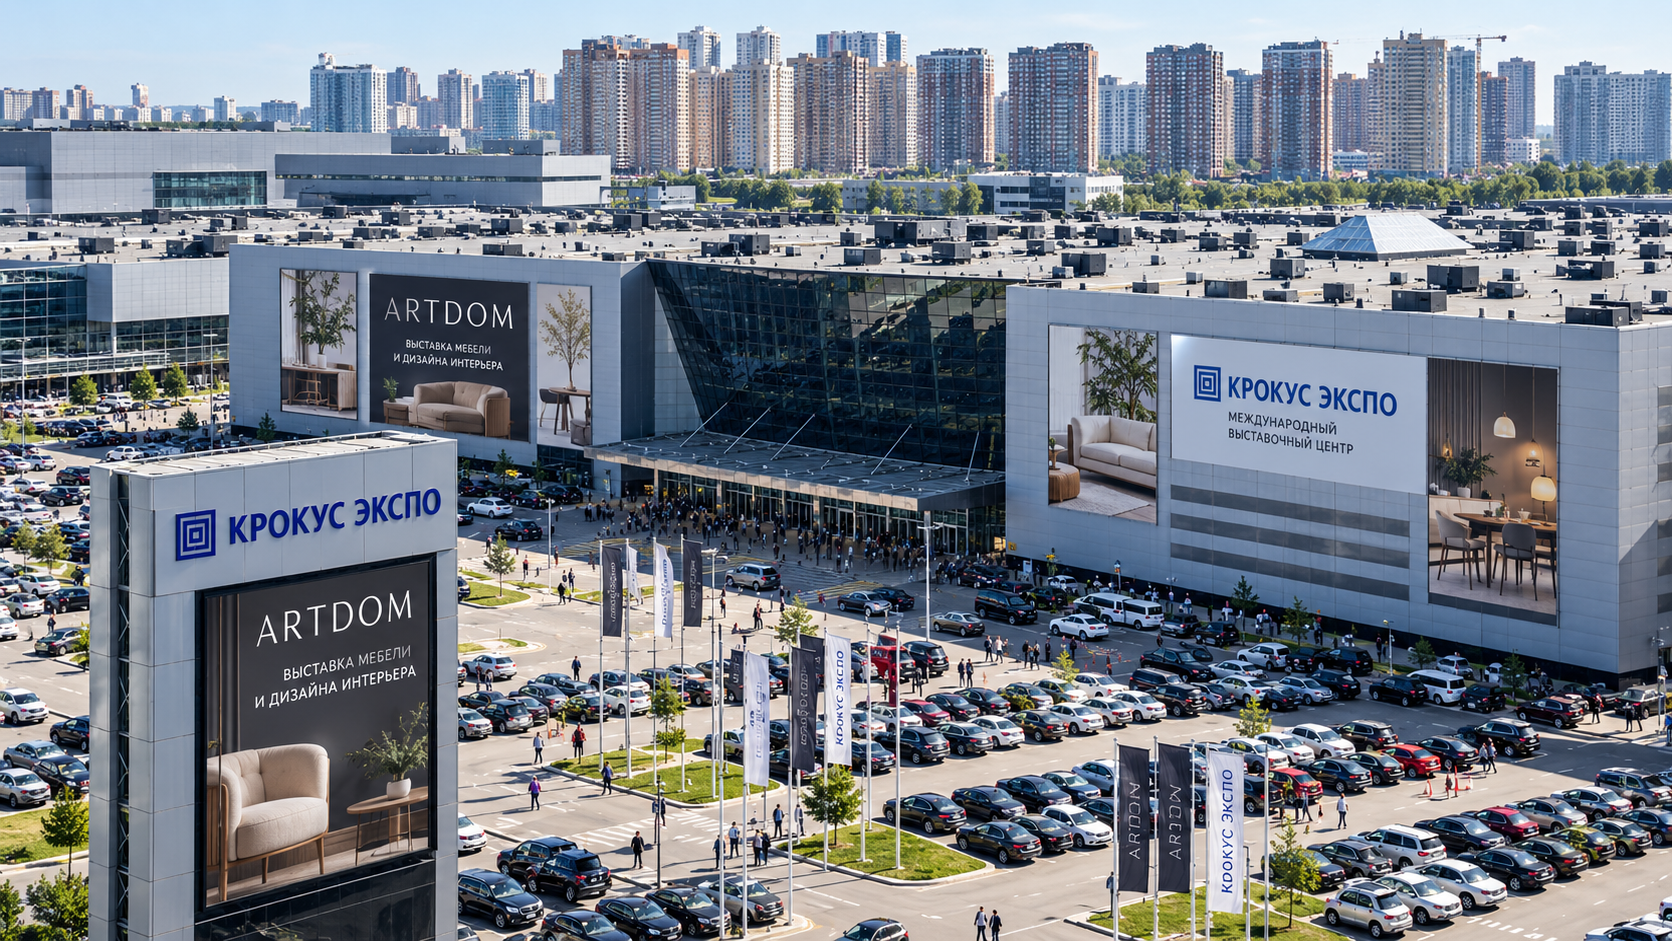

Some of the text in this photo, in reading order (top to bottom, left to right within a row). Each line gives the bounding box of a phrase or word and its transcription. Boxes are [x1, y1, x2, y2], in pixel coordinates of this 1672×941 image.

[384, 297, 513, 329] ARTDOM
[393, 353, 504, 371] И ДИЗАЙНА ИНТЕРЬЕРА
[405, 339, 491, 355] ВЫСТАВКА МЕБЕЛИ
[1228, 375, 1398, 417] КРОКУС ЭКСПО
[1228, 411, 1337, 435] МЕЖДУНАРОДНЫЙ
[1228, 428, 1354, 455] ВЫСТАВОЧНЫЙ ЦЕНТР
[229, 488, 442, 545] КРОКУС ЭКСПО
[256, 590, 412, 648] ARTDOM
[283, 645, 411, 681] ВЫСТАВКА МЕБЕЛИ
[835, 650, 844, 692] ЭКСПО
[255, 665, 417, 709] И ДИЗАЙНА ИНТЕРЬЕРА
[1221, 769, 1233, 823] ЭКСПО
